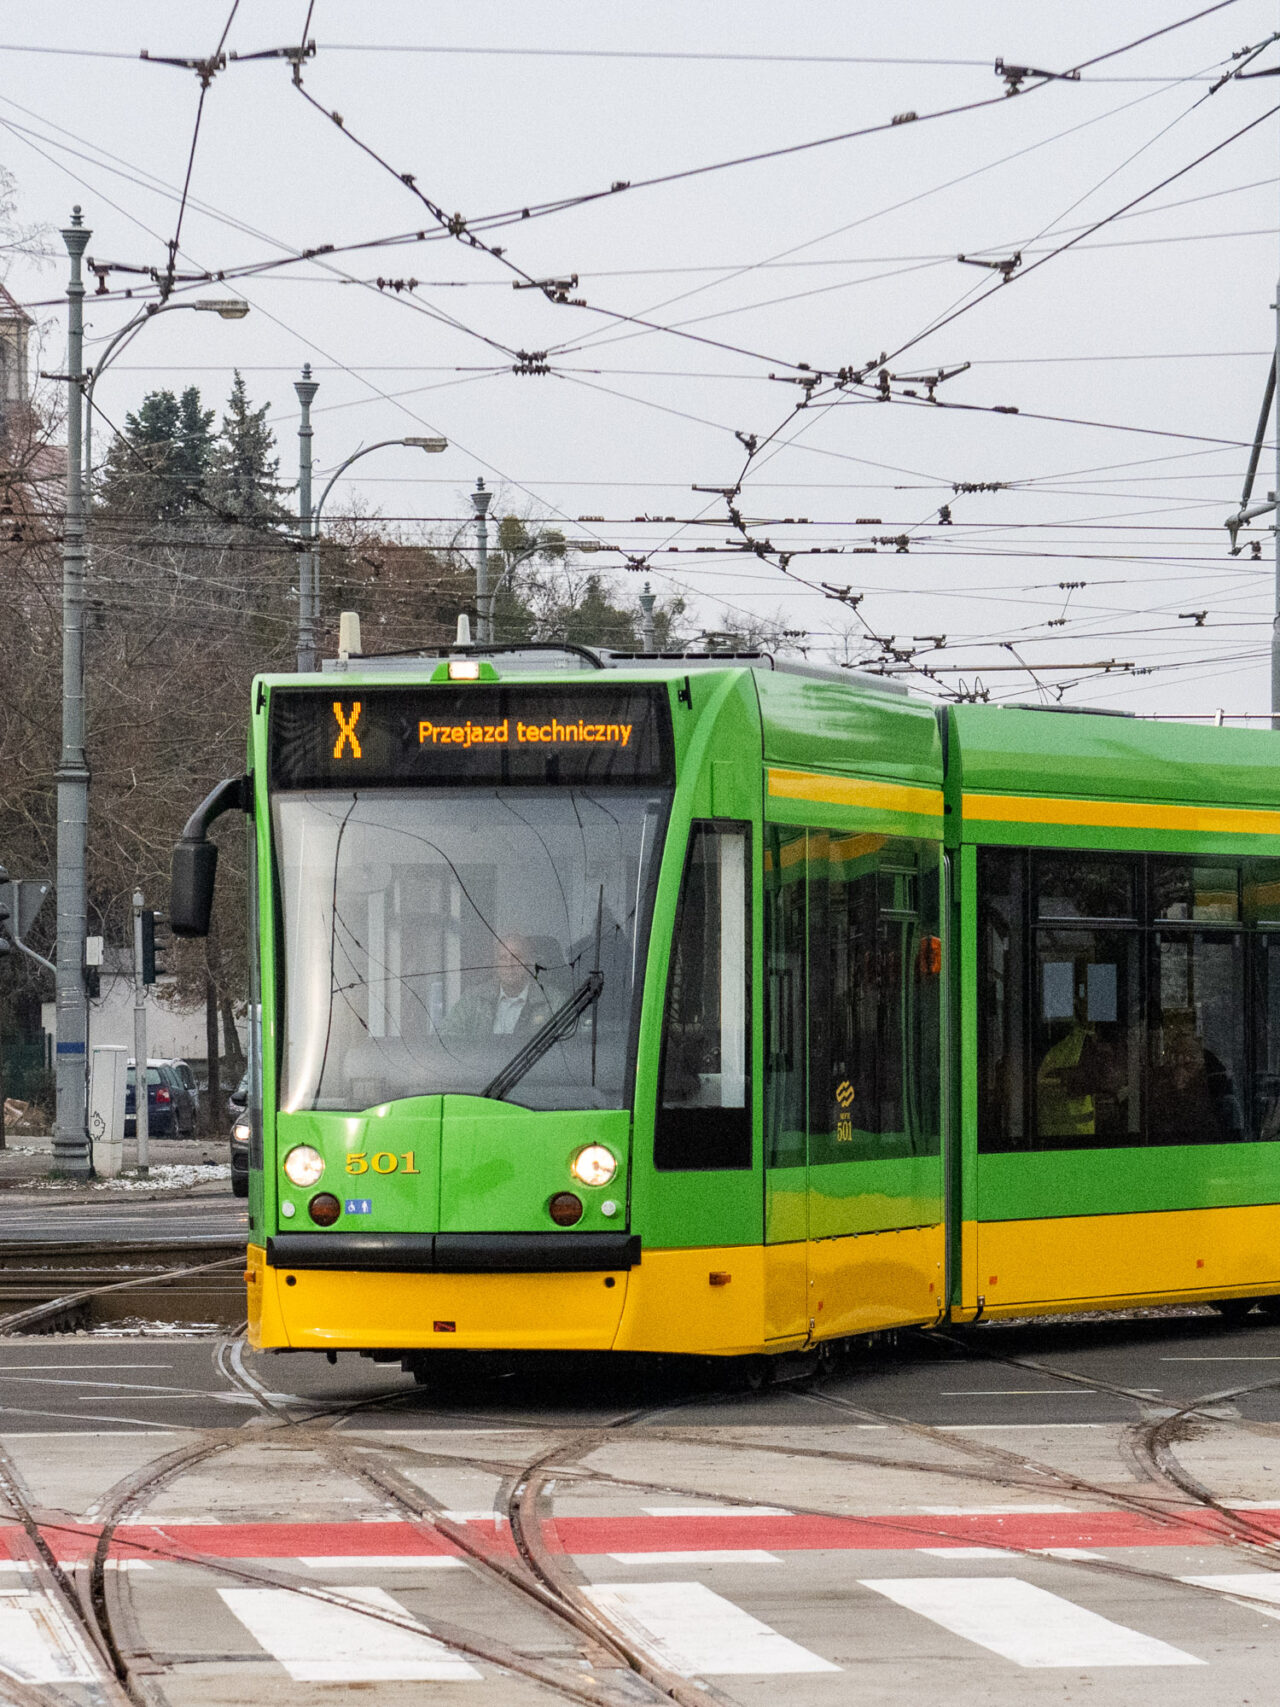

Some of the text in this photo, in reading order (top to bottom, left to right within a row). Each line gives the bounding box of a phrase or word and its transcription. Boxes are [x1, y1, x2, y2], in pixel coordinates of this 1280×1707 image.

[333, 702, 361, 758] X
[418, 718, 632, 748] Przejazd techniczny
[837, 1121, 852, 1142] 501
[345, 1151, 421, 1176] 501
